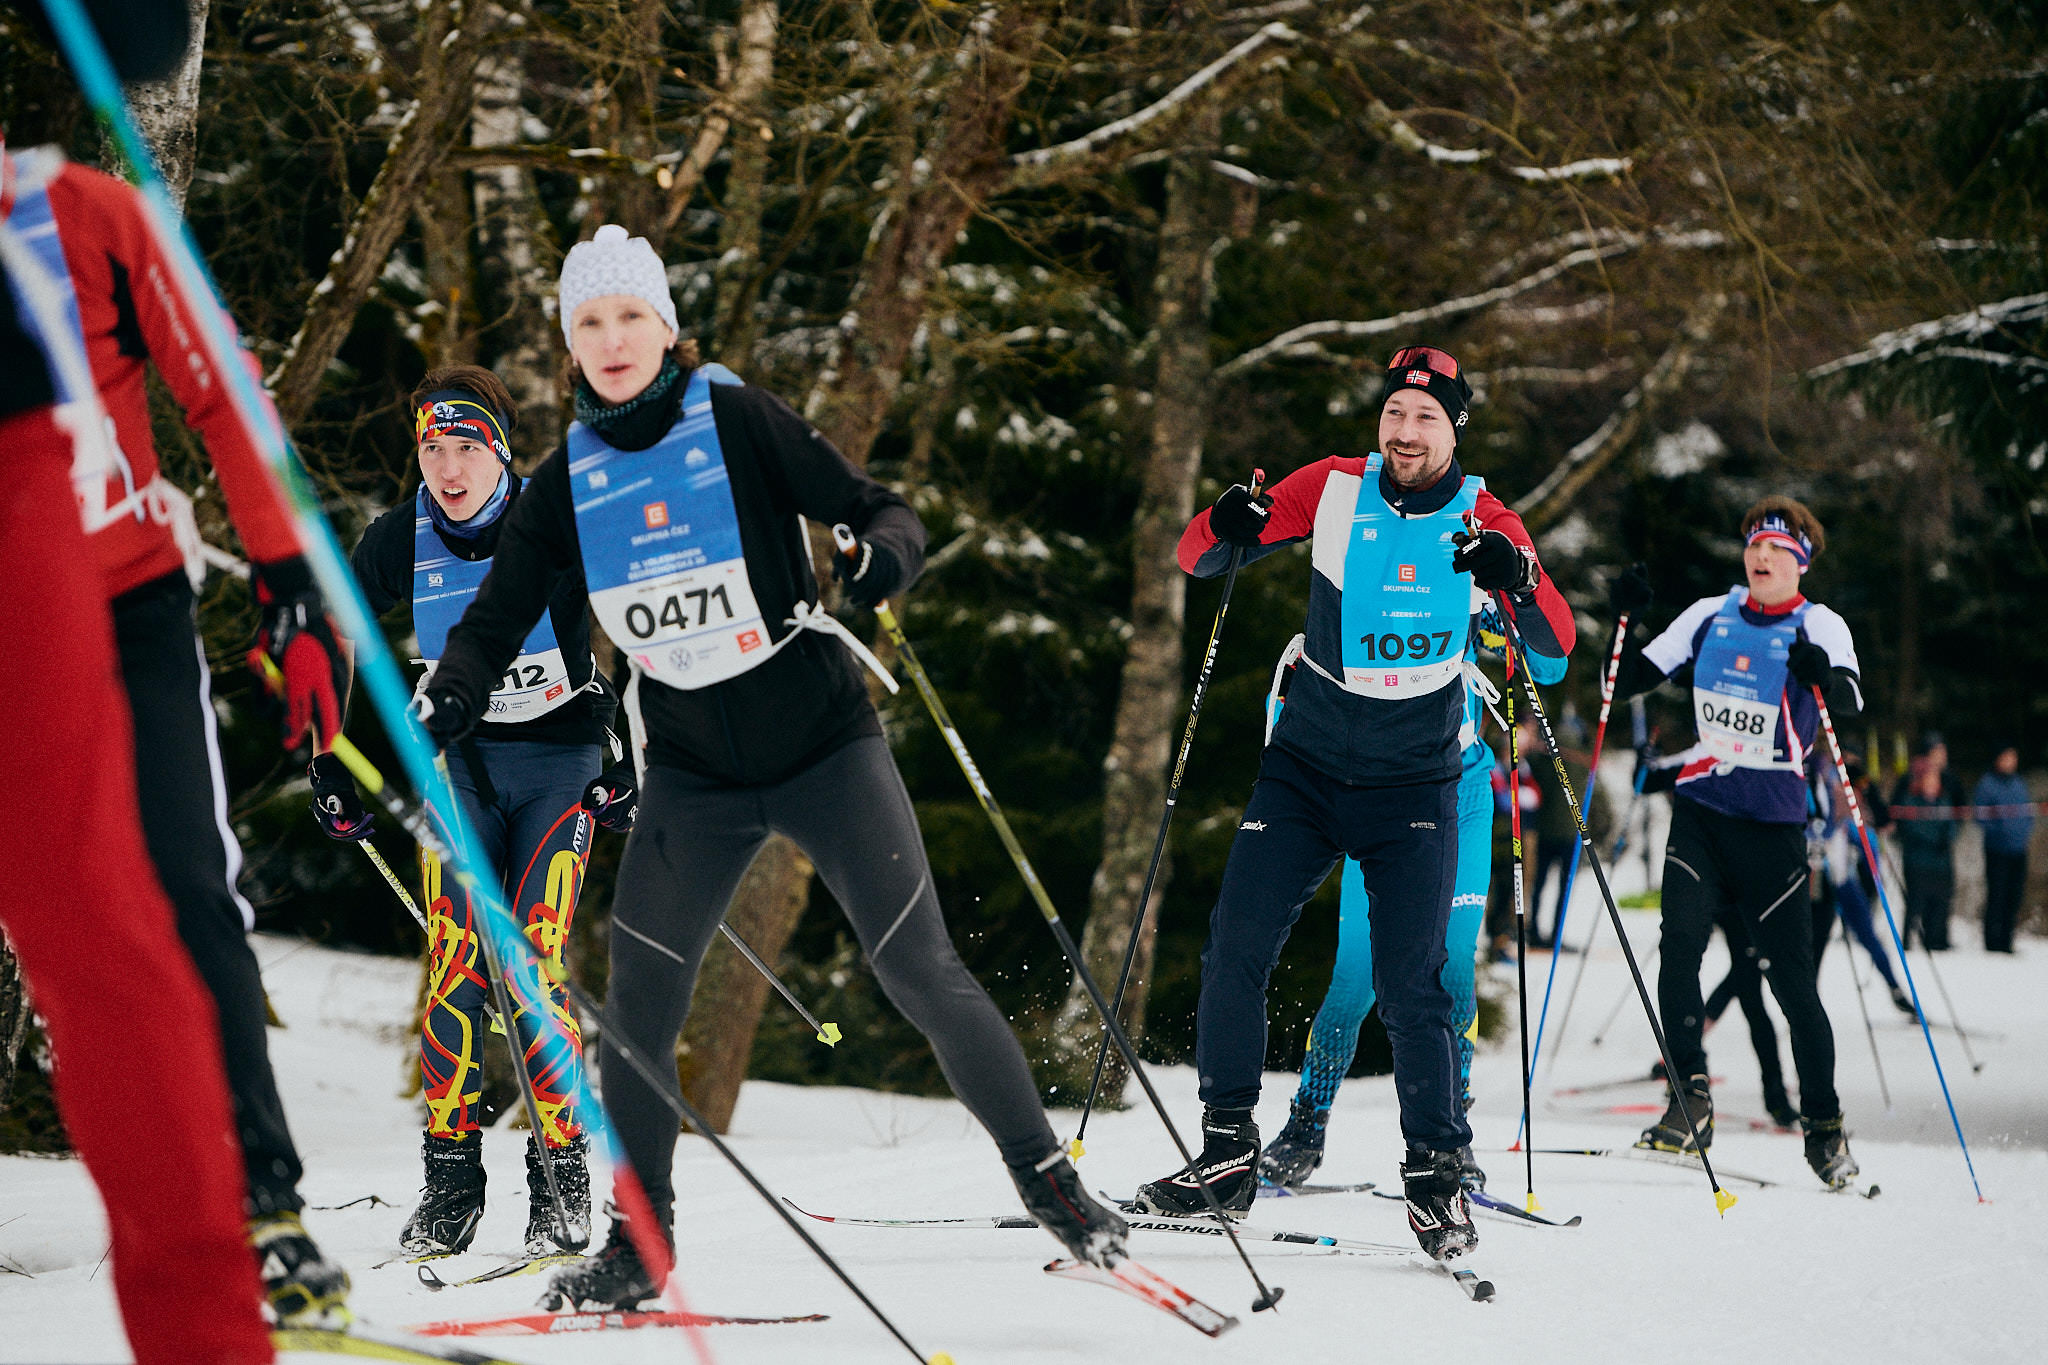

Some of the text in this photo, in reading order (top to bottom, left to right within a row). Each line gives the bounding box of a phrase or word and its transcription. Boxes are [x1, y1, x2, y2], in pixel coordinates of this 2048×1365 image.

[430, 422, 478, 432] ROVER PRAHA
[1383, 584, 1431, 593] SKUPINA ČEZ
[625, 584, 734, 639] 0471
[1360, 630, 1453, 661] 1097
[1506, 687, 1515, 724] LEKI
[1524, 682, 1543, 718] LEKI
[1703, 702, 1765, 735] 0488
[572, 810, 587, 853] ATEX
[433, 1153, 466, 1161] salomon
